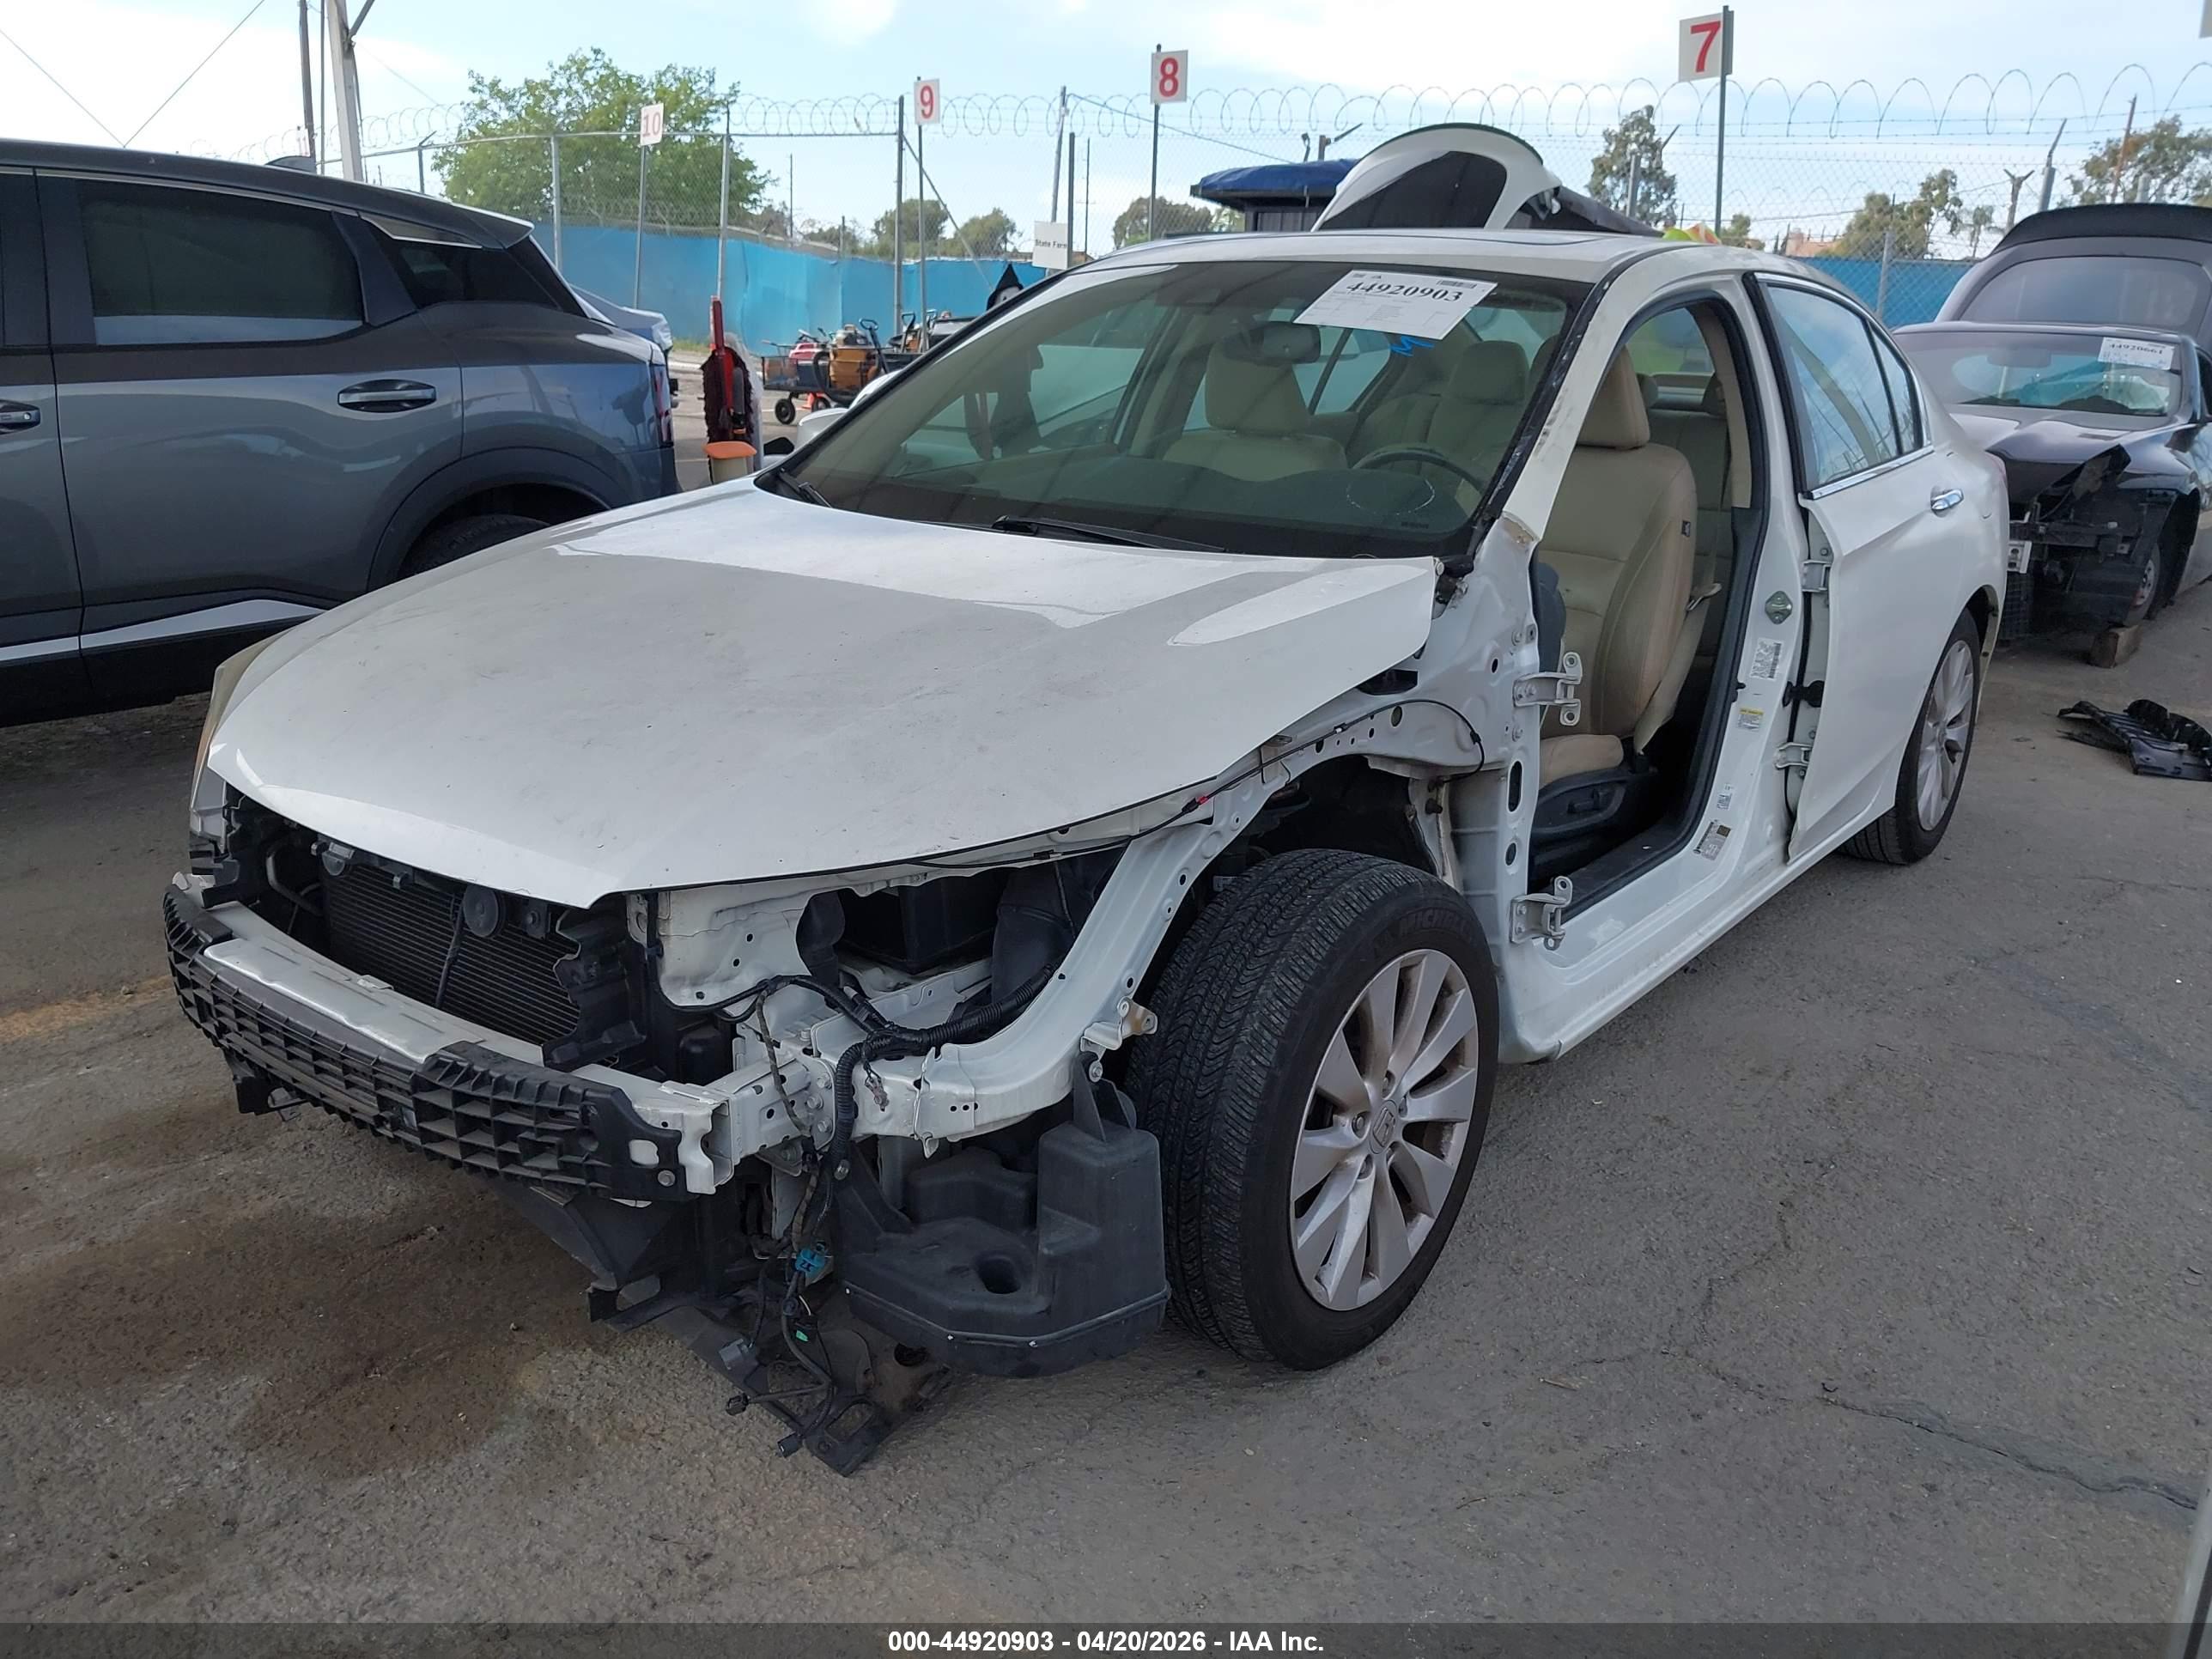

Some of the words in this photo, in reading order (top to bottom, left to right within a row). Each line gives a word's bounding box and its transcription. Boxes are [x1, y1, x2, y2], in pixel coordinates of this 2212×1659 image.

[1690, 20, 1721, 73] 7
[1159, 57, 1179, 97] 8
[920, 85, 934, 119] 9
[642, 112, 661, 137] 10
[1346, 282, 1463, 301] 44920903
